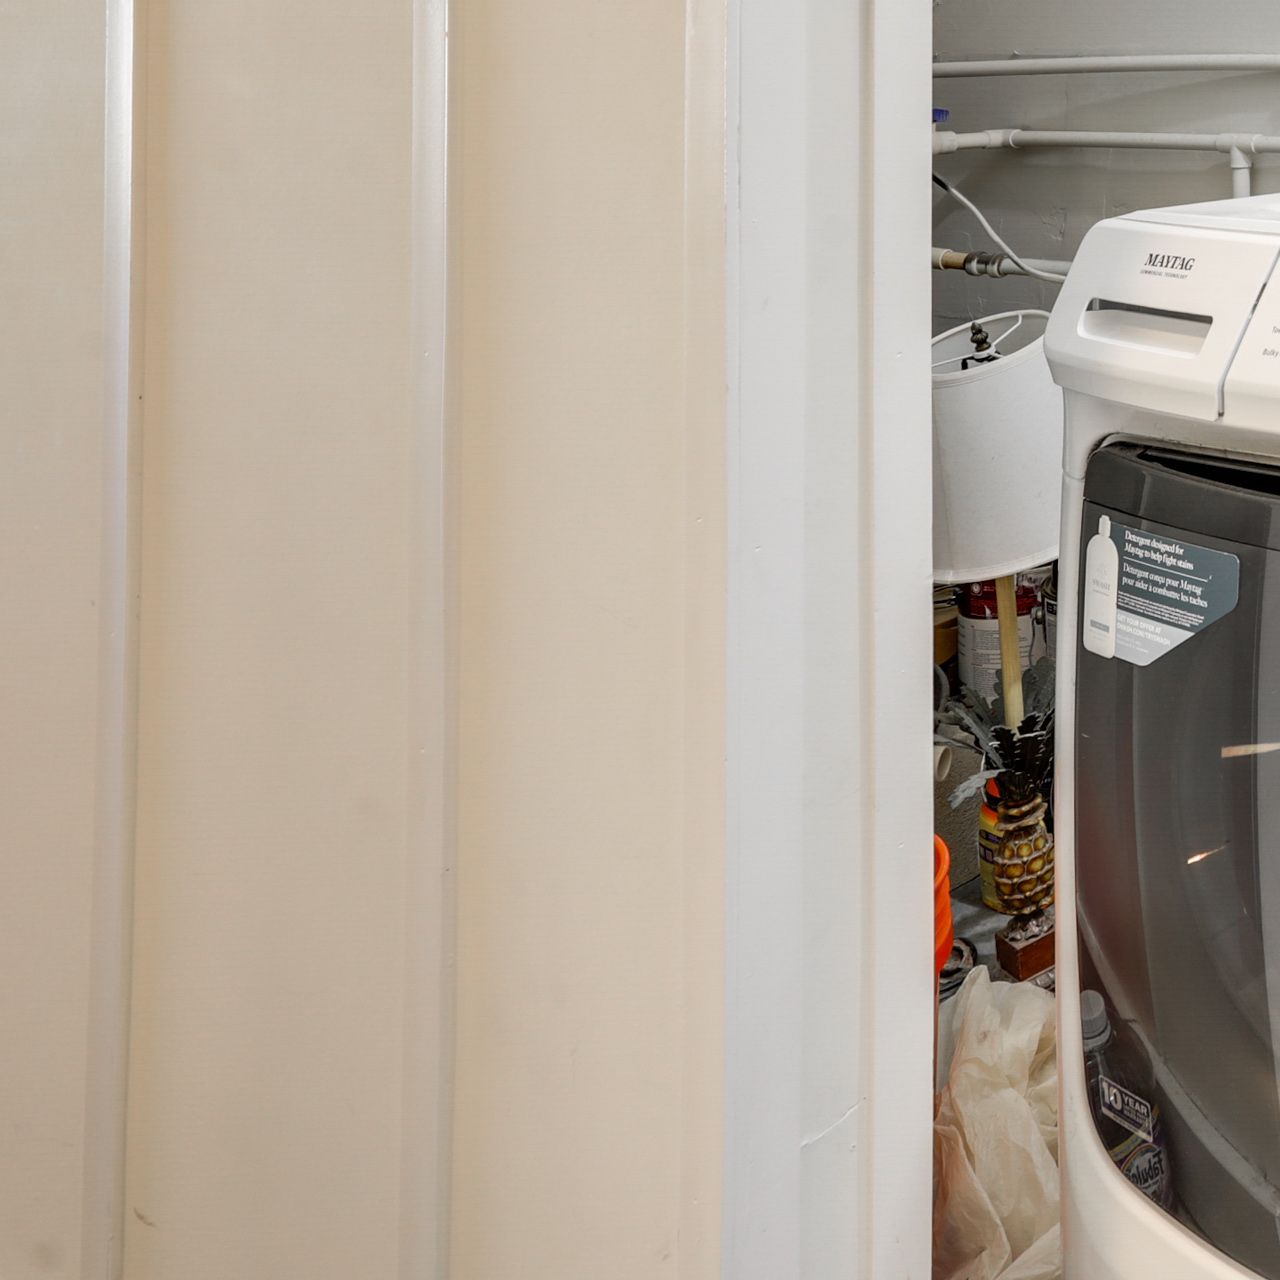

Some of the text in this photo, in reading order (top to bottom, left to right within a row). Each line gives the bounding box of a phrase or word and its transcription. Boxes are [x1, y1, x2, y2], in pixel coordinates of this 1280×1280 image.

[1144, 253, 1196, 271] MAYTAG
[1262, 348, 1279, 358] Bulky
[1125, 530, 1184, 555] Detergent designed for
[1124, 542, 1194, 570] Maytag to help fight stains
[1122, 576, 1135, 586] pour
[1180, 592, 1189, 602] les
[1189, 595, 1208, 608] taches
[1165, 577, 1180, 587] pour
[1180, 580, 1202, 595] Maytag
[1102, 1081, 1148, 1116] 10 YEAR
